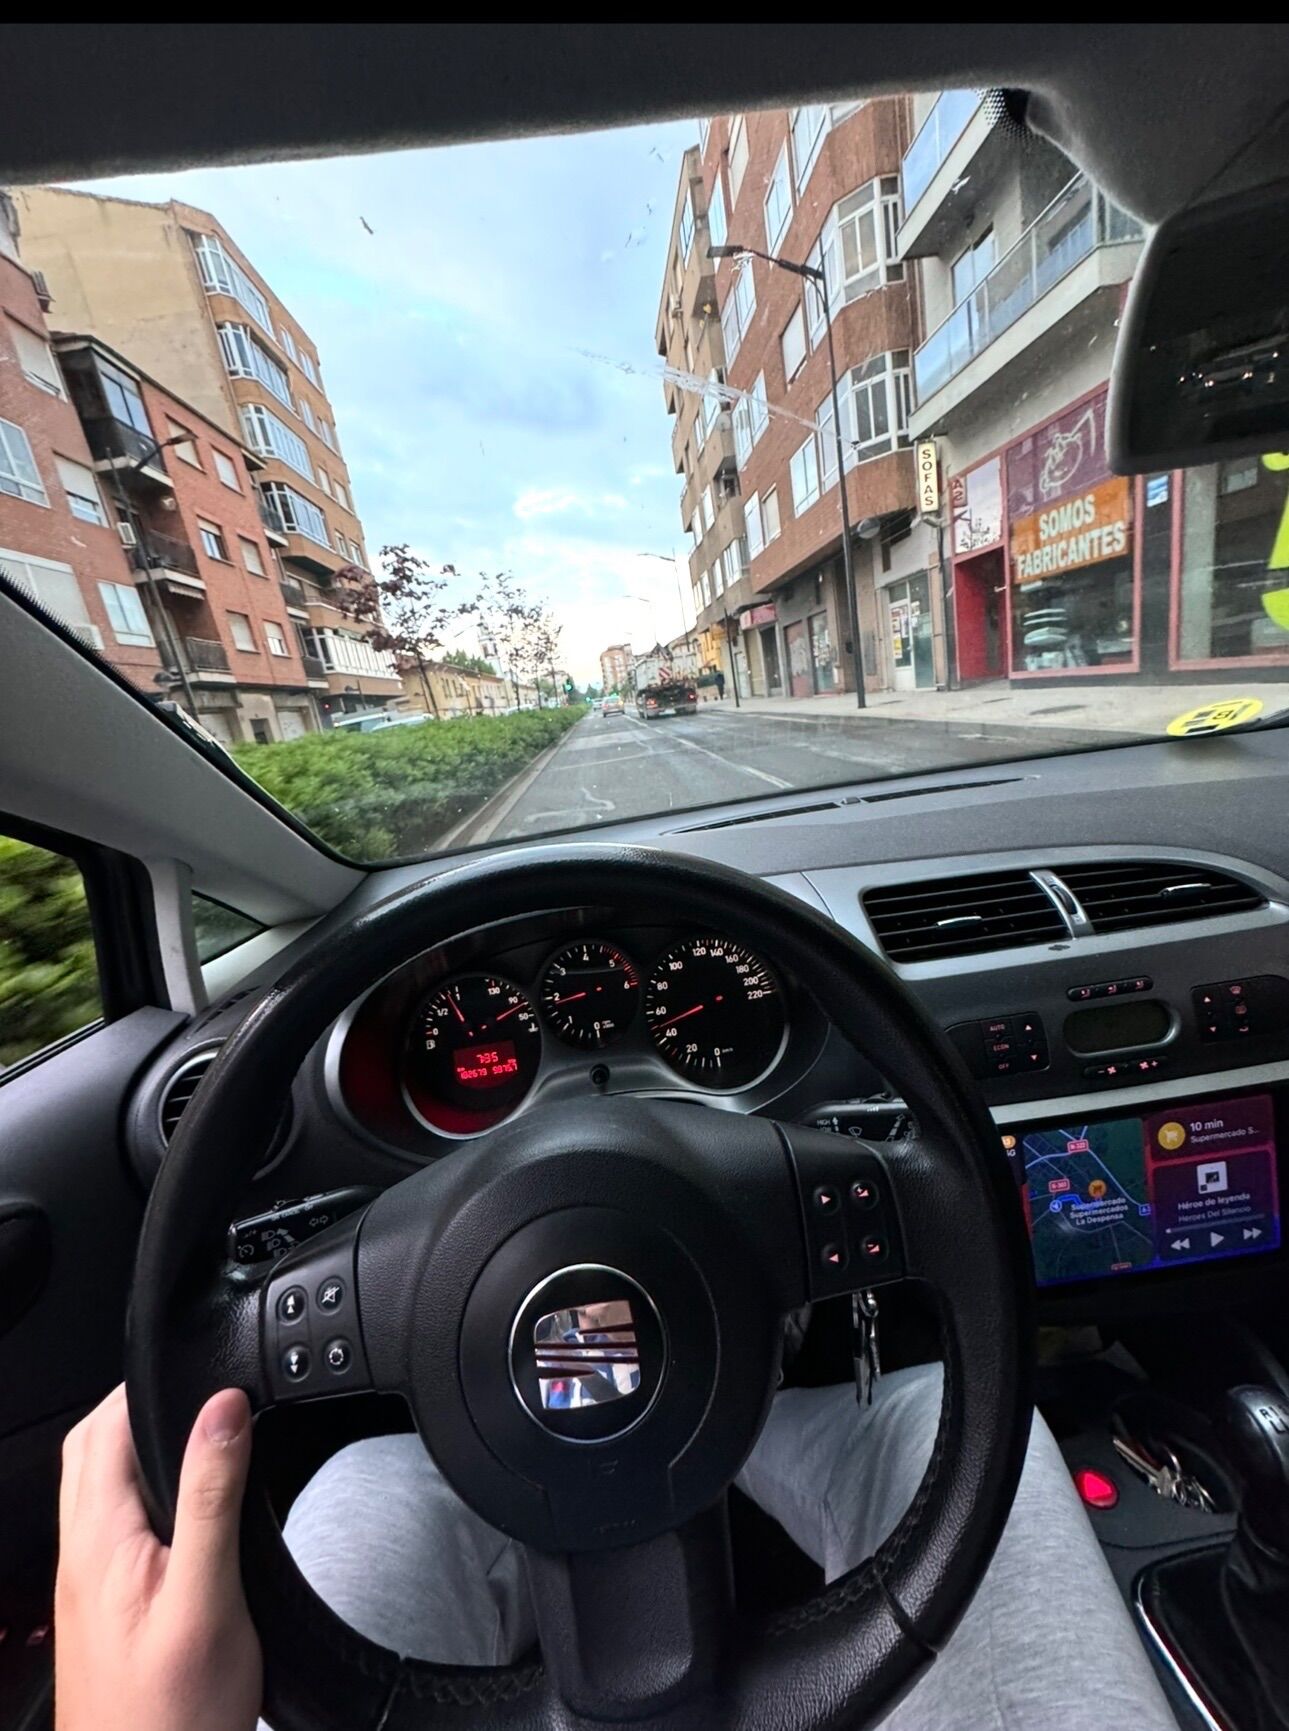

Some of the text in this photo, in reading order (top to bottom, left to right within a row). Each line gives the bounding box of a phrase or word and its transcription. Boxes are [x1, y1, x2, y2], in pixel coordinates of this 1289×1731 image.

[922, 449, 934, 506] SOFAS
[1039, 494, 1095, 541] SOMOS
[1015, 520, 1126, 578] FABRICANTES
[692, 947, 706, 956] 120
[583, 953, 589, 961] 4
[725, 954, 739, 963] 160
[609, 959, 615, 968] 5
[669, 961, 683, 971] 100
[560, 967, 567, 976] 3
[736, 965, 749, 974] 180
[624, 980, 630, 989] 6
[743, 976, 759, 986] 200
[657, 981, 668, 991] 80
[488, 987, 501, 995] 130
[747, 990, 763, 1000] 220
[508, 996, 519, 1004] 90
[553, 992, 560, 1001] 2
[437, 1007, 449, 1017] 1/2
[655, 1006, 667, 1016] 60
[519, 1012, 529, 1021] 50
[568, 1015, 573, 1024] 1
[593, 1021, 600, 1030] 0
[990, 1024, 1005, 1032] AUTO
[432, 1027, 439, 1036] 0
[665, 1028, 678, 1037] 40
[686, 1043, 698, 1053] 20
[714, 1047, 721, 1056] 0
[1190, 1119, 1224, 1132] 10 min
[1190, 1128, 1247, 1144] Supermercado
[1204, 1198, 1216, 1206] de
[1217, 1192, 1251, 1204] leyenda
[1070, 1205, 1128, 1219] Supermercados
[1207, 1209, 1220, 1217] Del
[1089, 1212, 1124, 1223] Despensa
[1259, 1408, 1273, 1419] R
